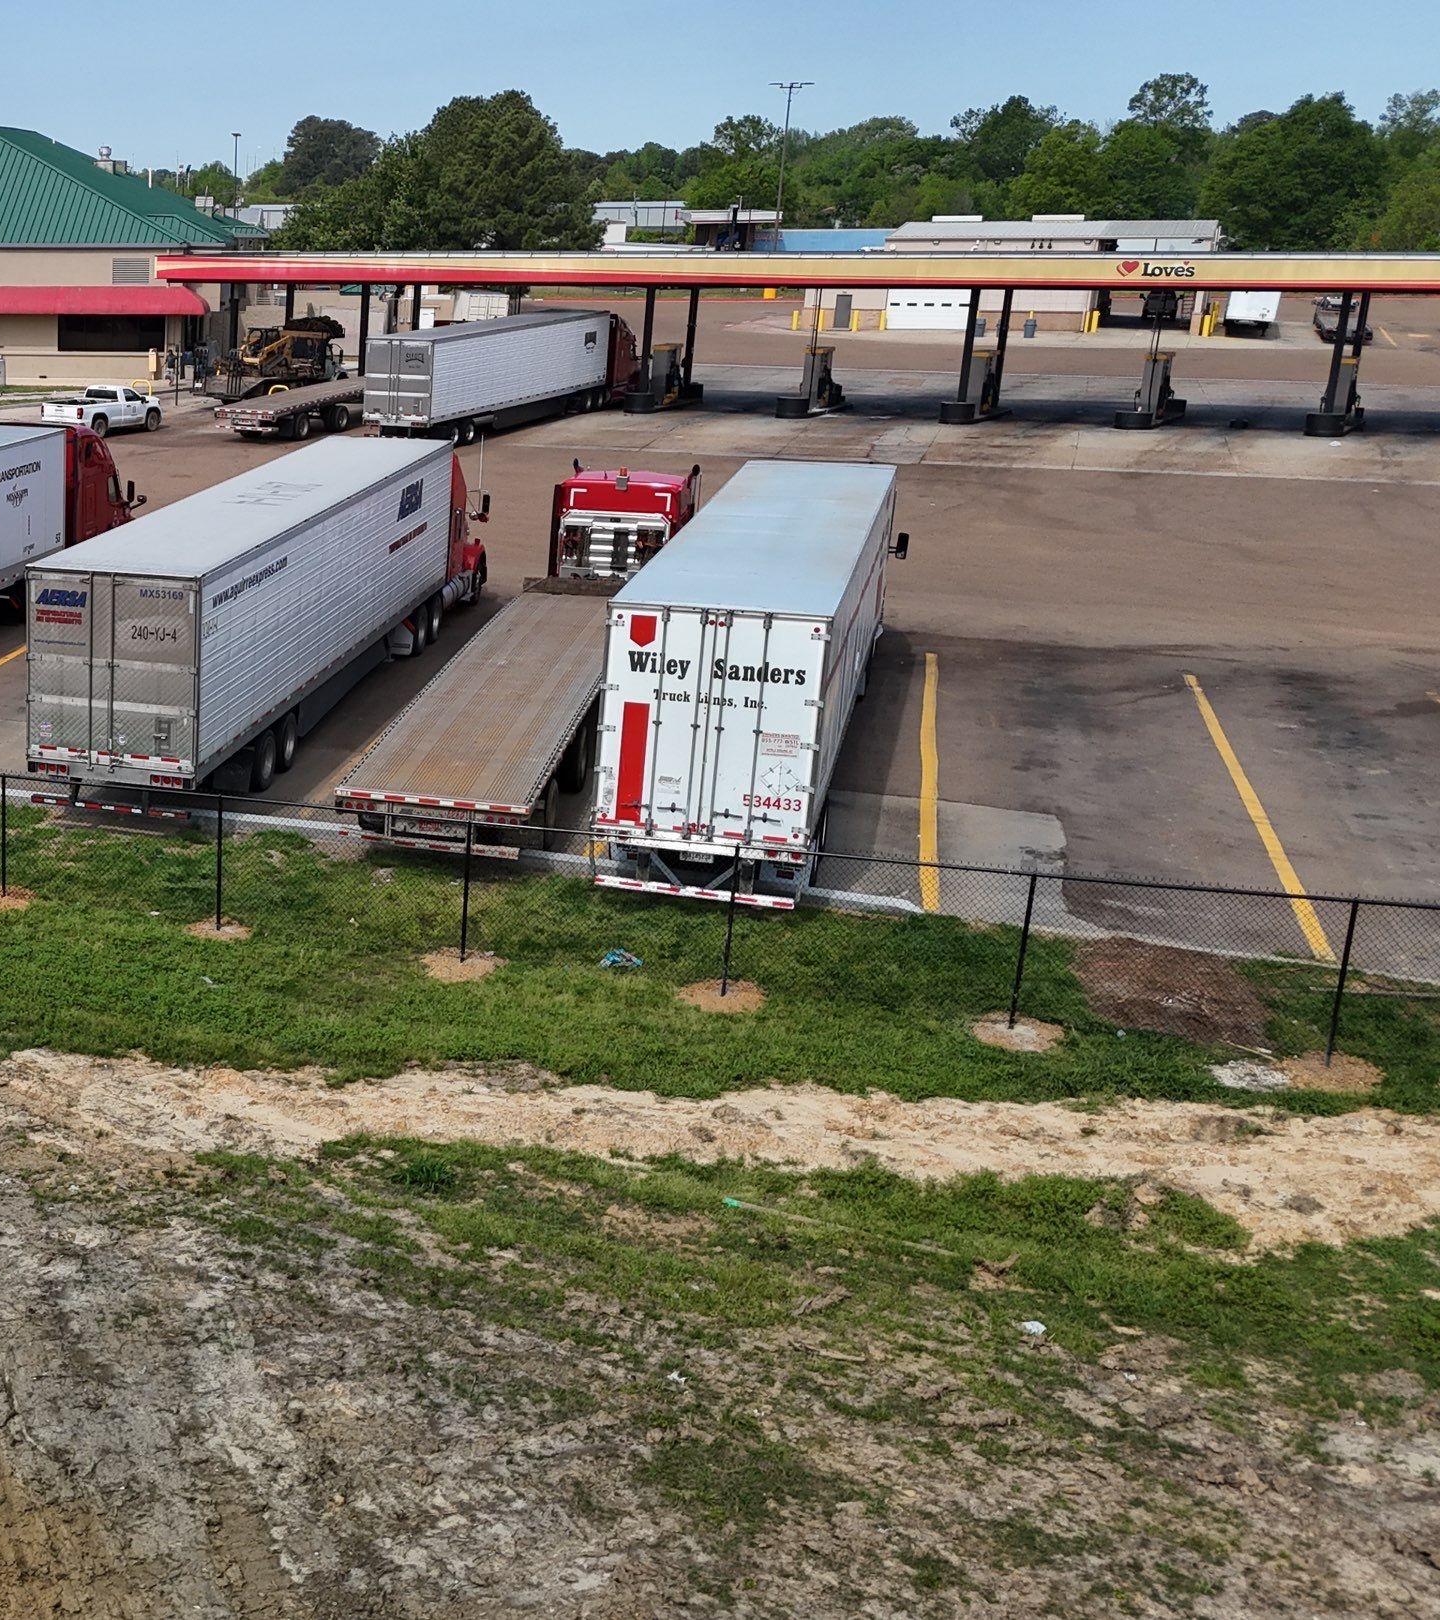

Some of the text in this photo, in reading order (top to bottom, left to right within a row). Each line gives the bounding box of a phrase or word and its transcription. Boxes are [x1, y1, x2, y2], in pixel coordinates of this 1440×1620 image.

[1141, 261, 1195, 277] Love's
[35, 588, 87, 608] AERSA
[139, 589, 184, 600] MX53169
[131, 625, 177, 642] 240-YJ-4
[628, 650, 806, 685] Wiley Sanders
[653, 689, 768, 710] Truck Lines, Inc.
[742, 793, 802, 811] 534433
